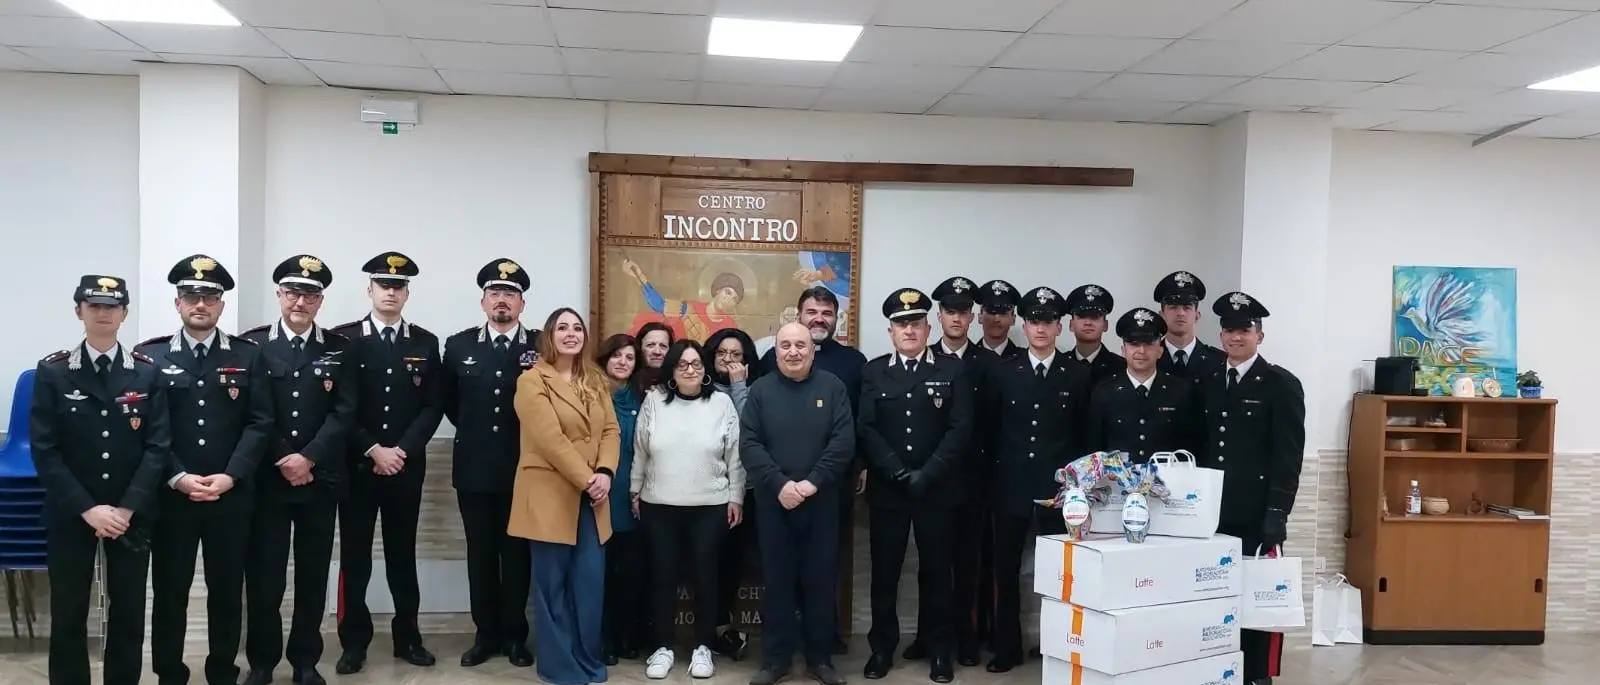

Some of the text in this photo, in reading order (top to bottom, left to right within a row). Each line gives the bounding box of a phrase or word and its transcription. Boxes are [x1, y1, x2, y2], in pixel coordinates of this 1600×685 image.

[698, 195, 766, 210] CENTRO
[663, 214, 798, 242] INCONTRO
[1135, 577, 1154, 588] Latte
[1066, 632, 1085, 647] Latte
[1146, 639, 1164, 650] Latte
